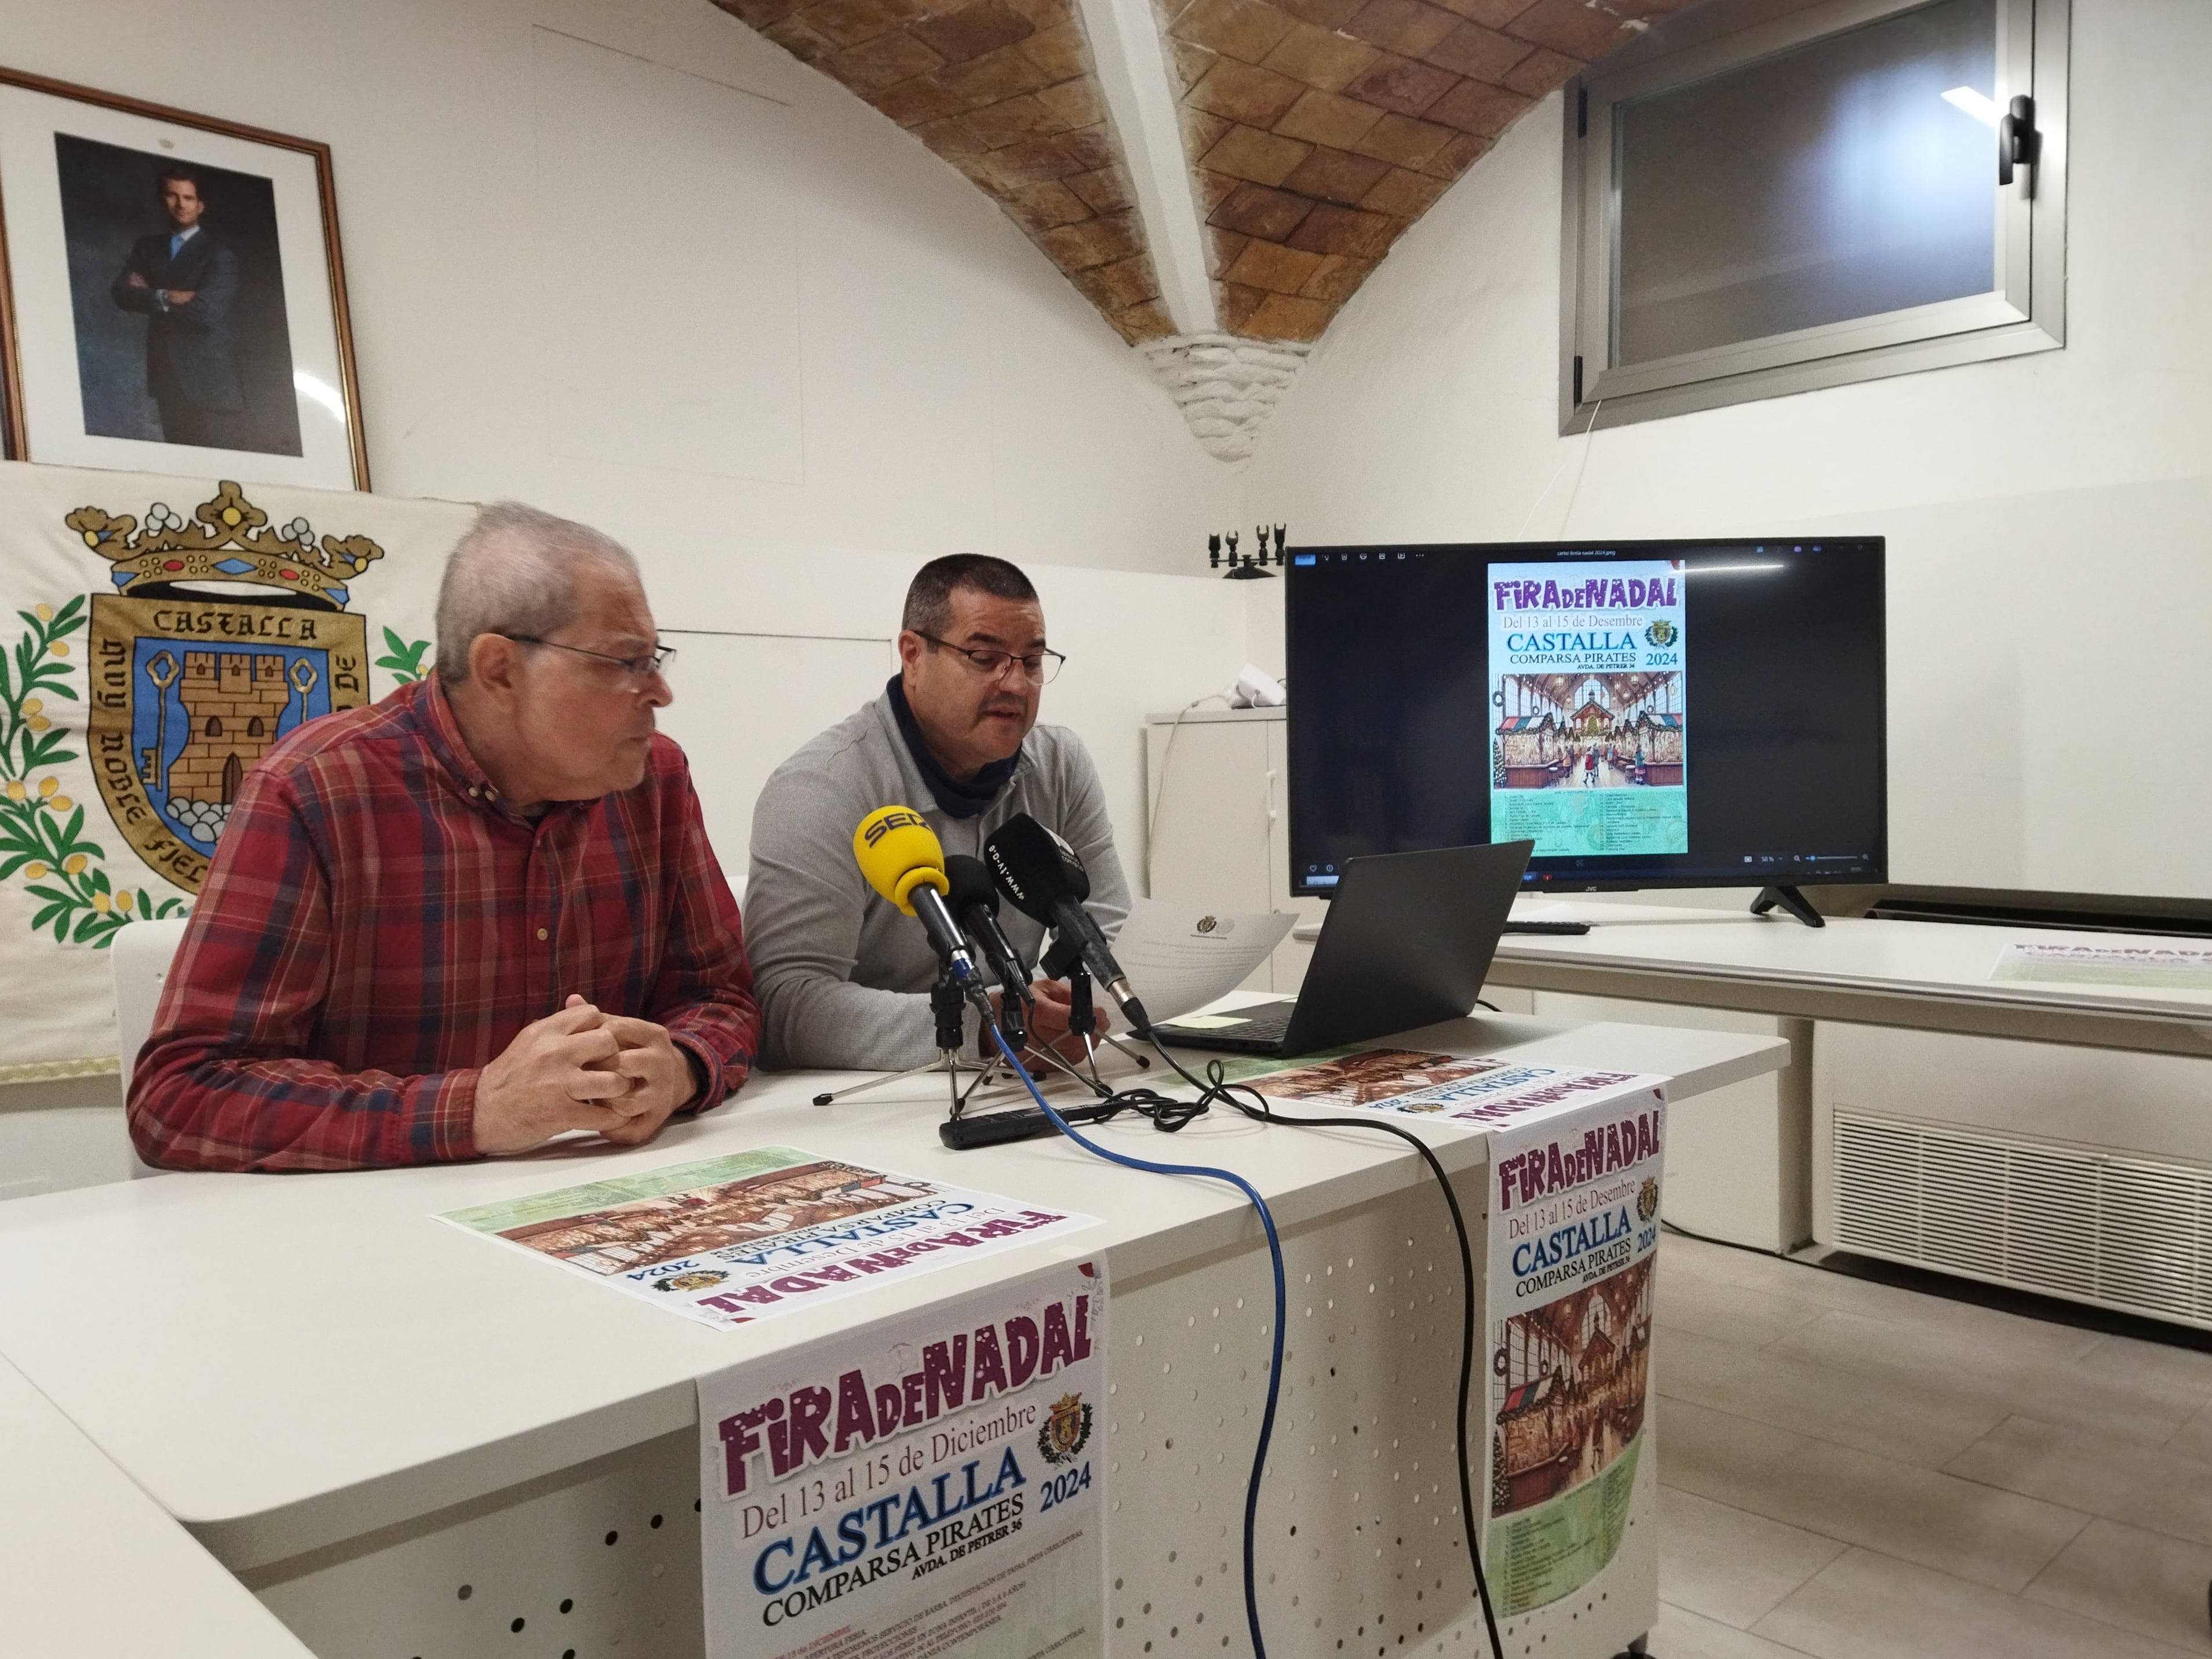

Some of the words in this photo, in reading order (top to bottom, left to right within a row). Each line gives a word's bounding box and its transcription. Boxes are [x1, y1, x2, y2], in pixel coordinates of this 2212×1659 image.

[153, 609, 318, 641] CASTALLA
[1503, 616, 1522, 629] Del
[1527, 616, 1539, 628] 13
[1543, 615, 1553, 628] al
[1557, 615, 1569, 628] 15
[1572, 615, 1586, 628] de
[1588, 614, 1643, 627] Desembre
[1506, 632, 1638, 652] CASTALLA
[1510, 654, 1581, 664] COMPARSA
[1585, 652, 1637, 663] PIRATES
[1645, 652, 1678, 666] 2024
[1426, 1069, 1555, 1100] CASTALLA
[819, 1199, 946, 1233] COMPARSA
[940, 1217, 967, 1227] 13
[971, 1208, 1004, 1219] Del
[1509, 1213, 1529, 1239] Del
[1535, 1209, 1546, 1231] 13
[1549, 1204, 1558, 1225] al
[1562, 1198, 1572, 1220] 15
[1576, 1194, 1588, 1215] de
[1590, 1179, 1636, 1210] Desembre
[724, 1204, 975, 1265] CASTALLA
[857, 1239, 884, 1249] de
[888, 1232, 913, 1242] 15
[915, 1225, 938, 1234] al
[1512, 1205, 1632, 1278] CASTALLA
[716, 1231, 823, 1260] PIRATES
[626, 1259, 700, 1281] 2024
[745, 1246, 856, 1278] Desembre
[1515, 1256, 1586, 1297] COMPARSA
[1588, 1238, 1631, 1270] PIRATES
[741, 1494, 788, 1540] Del
[797, 1480, 826, 1518] 13
[834, 1470, 855, 1505] al
[868, 1454, 891, 1490] 15
[899, 1445, 924, 1478] de
[931, 1402, 1037, 1466] Diciembre
[1040, 1462, 1092, 1514] 2024
[753, 1446, 1028, 1596] CASTALLA
[762, 1541, 922, 1627] COMPARSA
[926, 1493, 1025, 1558] PIRATES
[912, 1555, 948, 1581] AVDA.
[950, 1544, 966, 1562] DE
[967, 1525, 1010, 1555] PETRER
[1010, 1521, 1023, 1533] 36
